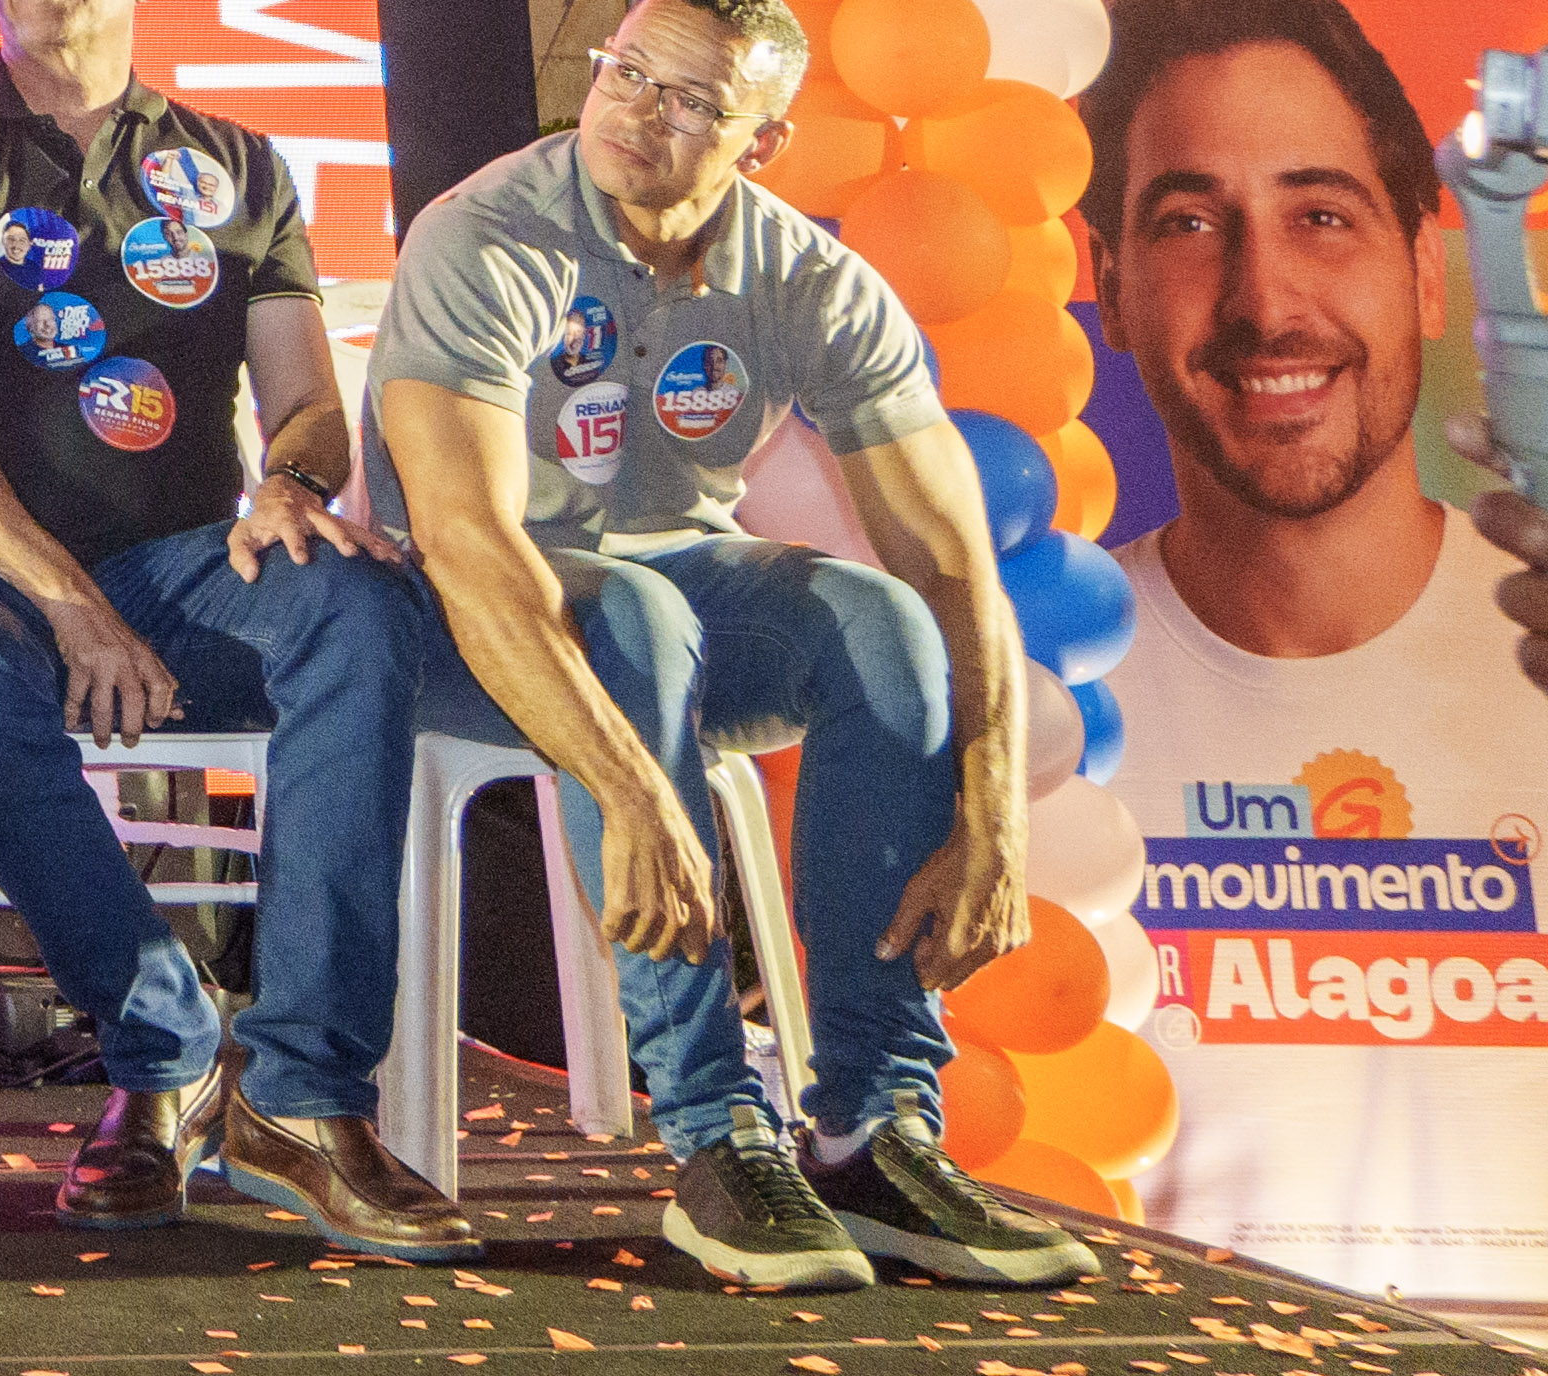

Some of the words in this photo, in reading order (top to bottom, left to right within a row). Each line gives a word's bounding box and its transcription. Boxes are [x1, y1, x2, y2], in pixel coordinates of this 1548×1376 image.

[43, 254, 71, 271] 1111
[132, 256, 212, 280] 15888
[129, 383, 165, 420] 15
[661, 390, 739, 412] 15888
[1196, 781, 1300, 832] Um
[1144, 845, 1517, 912] movimento
[1206, 937, 1548, 1040] Alagoa
